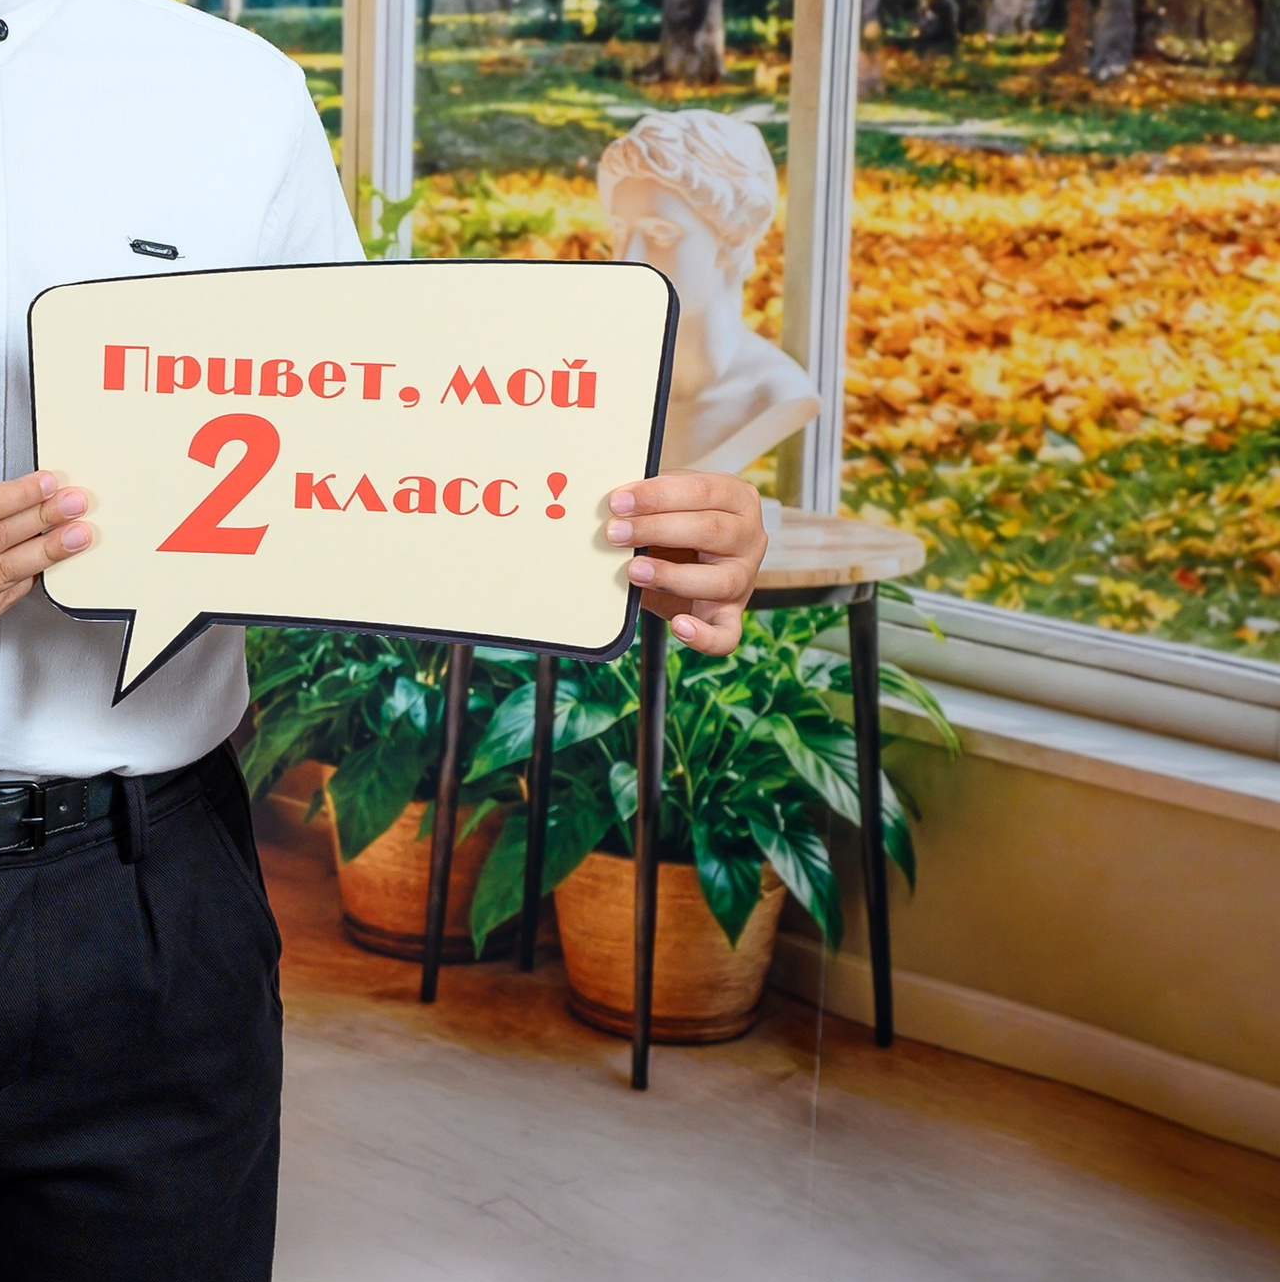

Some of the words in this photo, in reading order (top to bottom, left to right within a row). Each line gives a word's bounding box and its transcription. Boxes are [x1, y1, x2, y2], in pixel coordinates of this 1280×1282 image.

[103, 344, 421, 408] Привет,
[440, 358, 598, 409] мой
[156, 413, 281, 555] 2
[294, 472, 520, 518] класс
